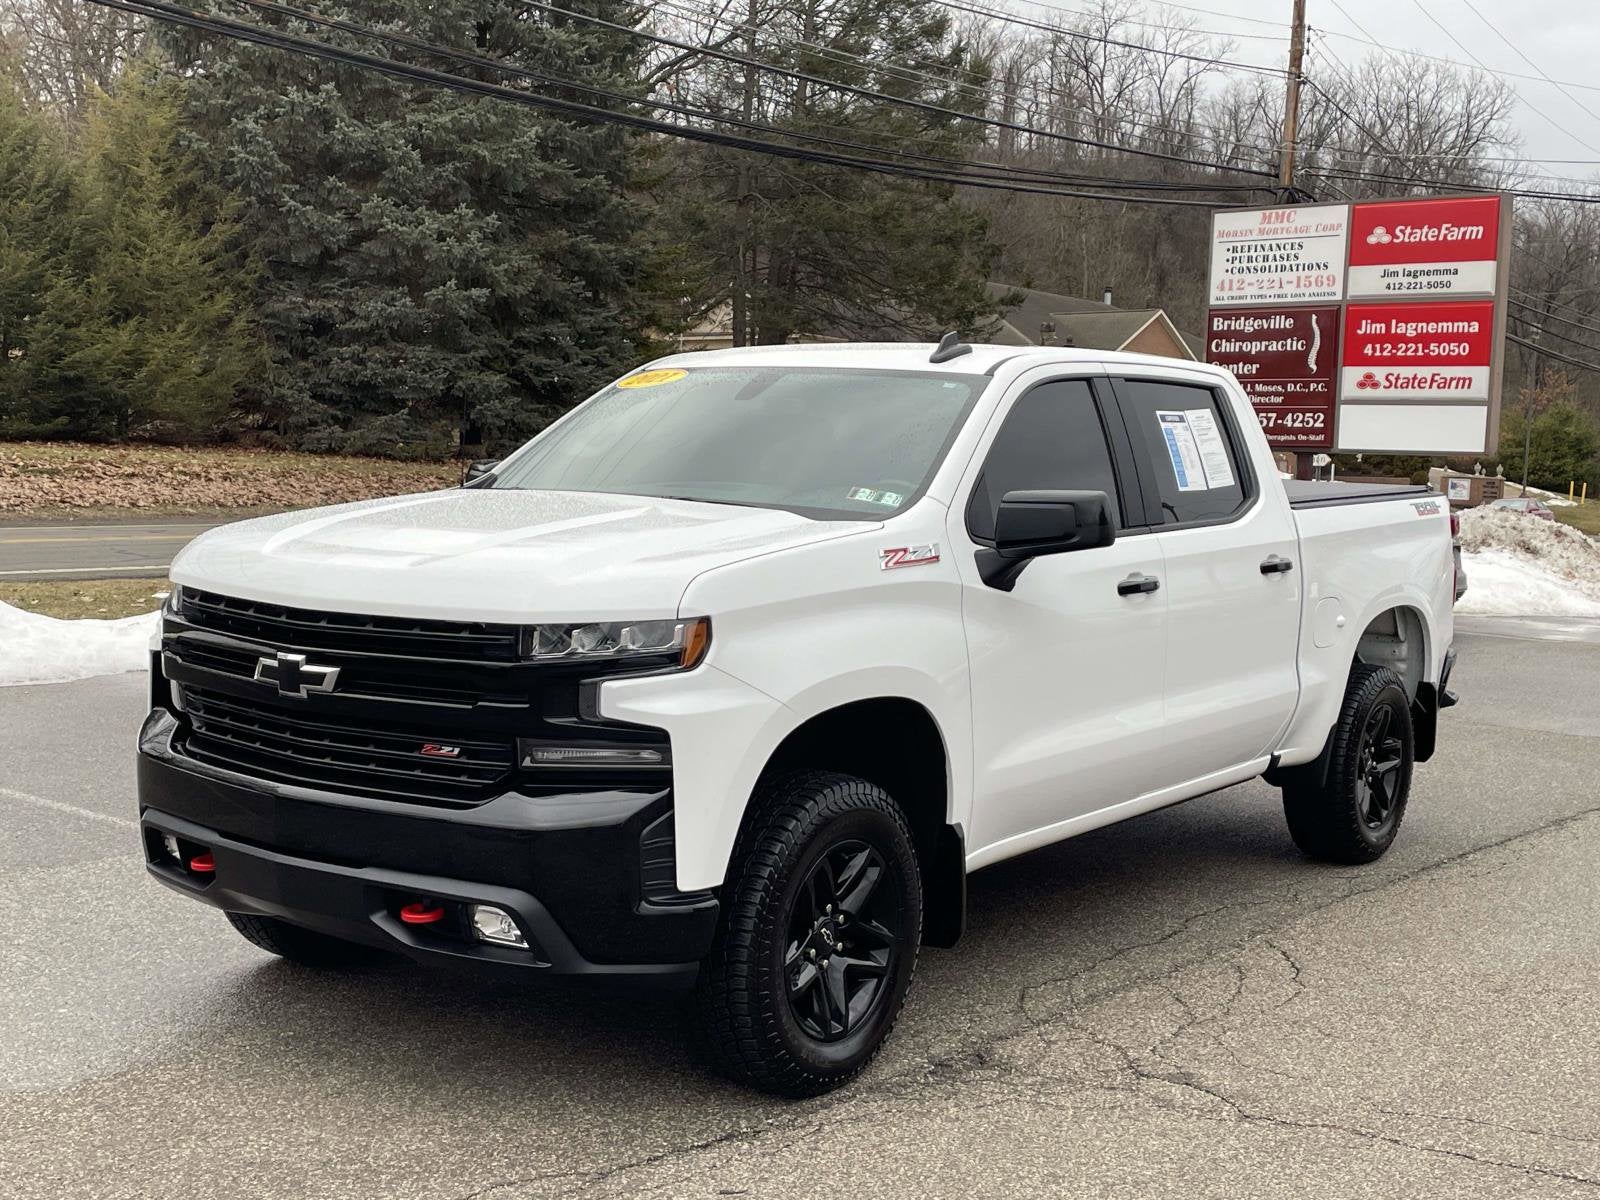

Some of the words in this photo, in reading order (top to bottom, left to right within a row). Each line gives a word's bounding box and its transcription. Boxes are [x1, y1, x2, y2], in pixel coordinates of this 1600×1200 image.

[1260, 211, 1296, 224] MMC
[1231, 241, 1304, 254] REFINANCES
[1231, 253, 1299, 264] PURCHASES
[1231, 262, 1329, 275] CONSOLIDATIONS
[1380, 268, 1399, 278] Jim
[1402, 268, 1459, 279] Iagnemma
[1217, 275, 1336, 291] 412-221-1569
[1385, 280, 1452, 291] 412-221-5050
[1213, 315, 1294, 333] Bridgeville
[1356, 319, 1386, 335] Jim
[1391, 319, 1480, 337] Iagnemma
[1211, 337, 1306, 354] Chiropractic
[1363, 343, 1470, 357] 412-221-5050
[1255, 383, 1285, 393] Moses,
[1249, 395, 1284, 404] Director
[879, 543, 940, 570] Z71
[420, 743, 461, 758] Z71
